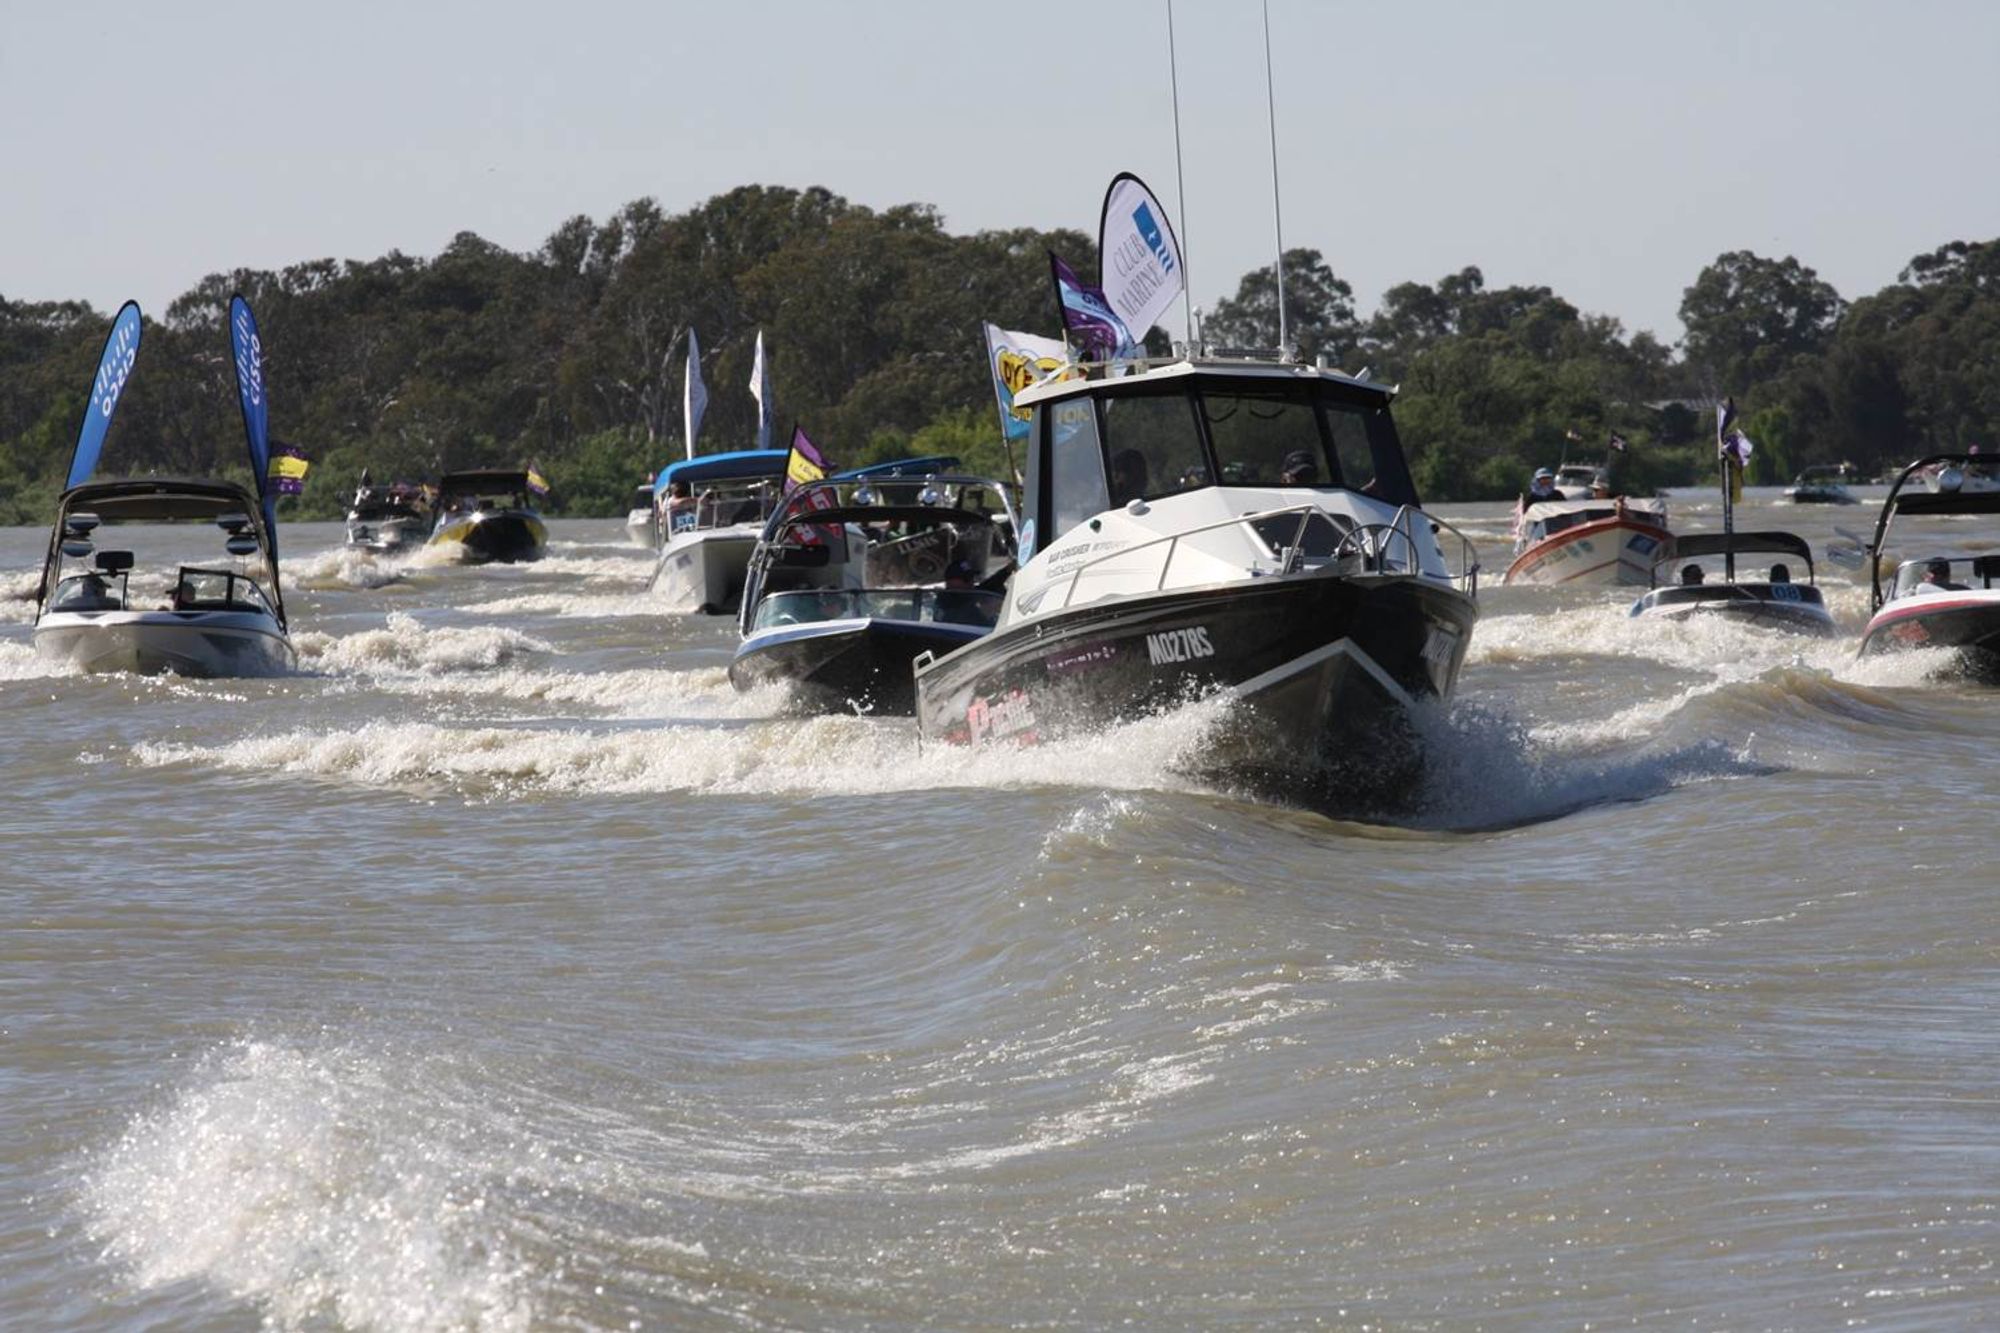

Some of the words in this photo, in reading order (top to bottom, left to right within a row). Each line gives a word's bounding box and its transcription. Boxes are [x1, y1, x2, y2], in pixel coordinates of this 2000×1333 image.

[1113, 232, 1147, 278] CLUB
[1117, 260, 1165, 320] MARINE
[250, 333, 261, 405] CISCO
